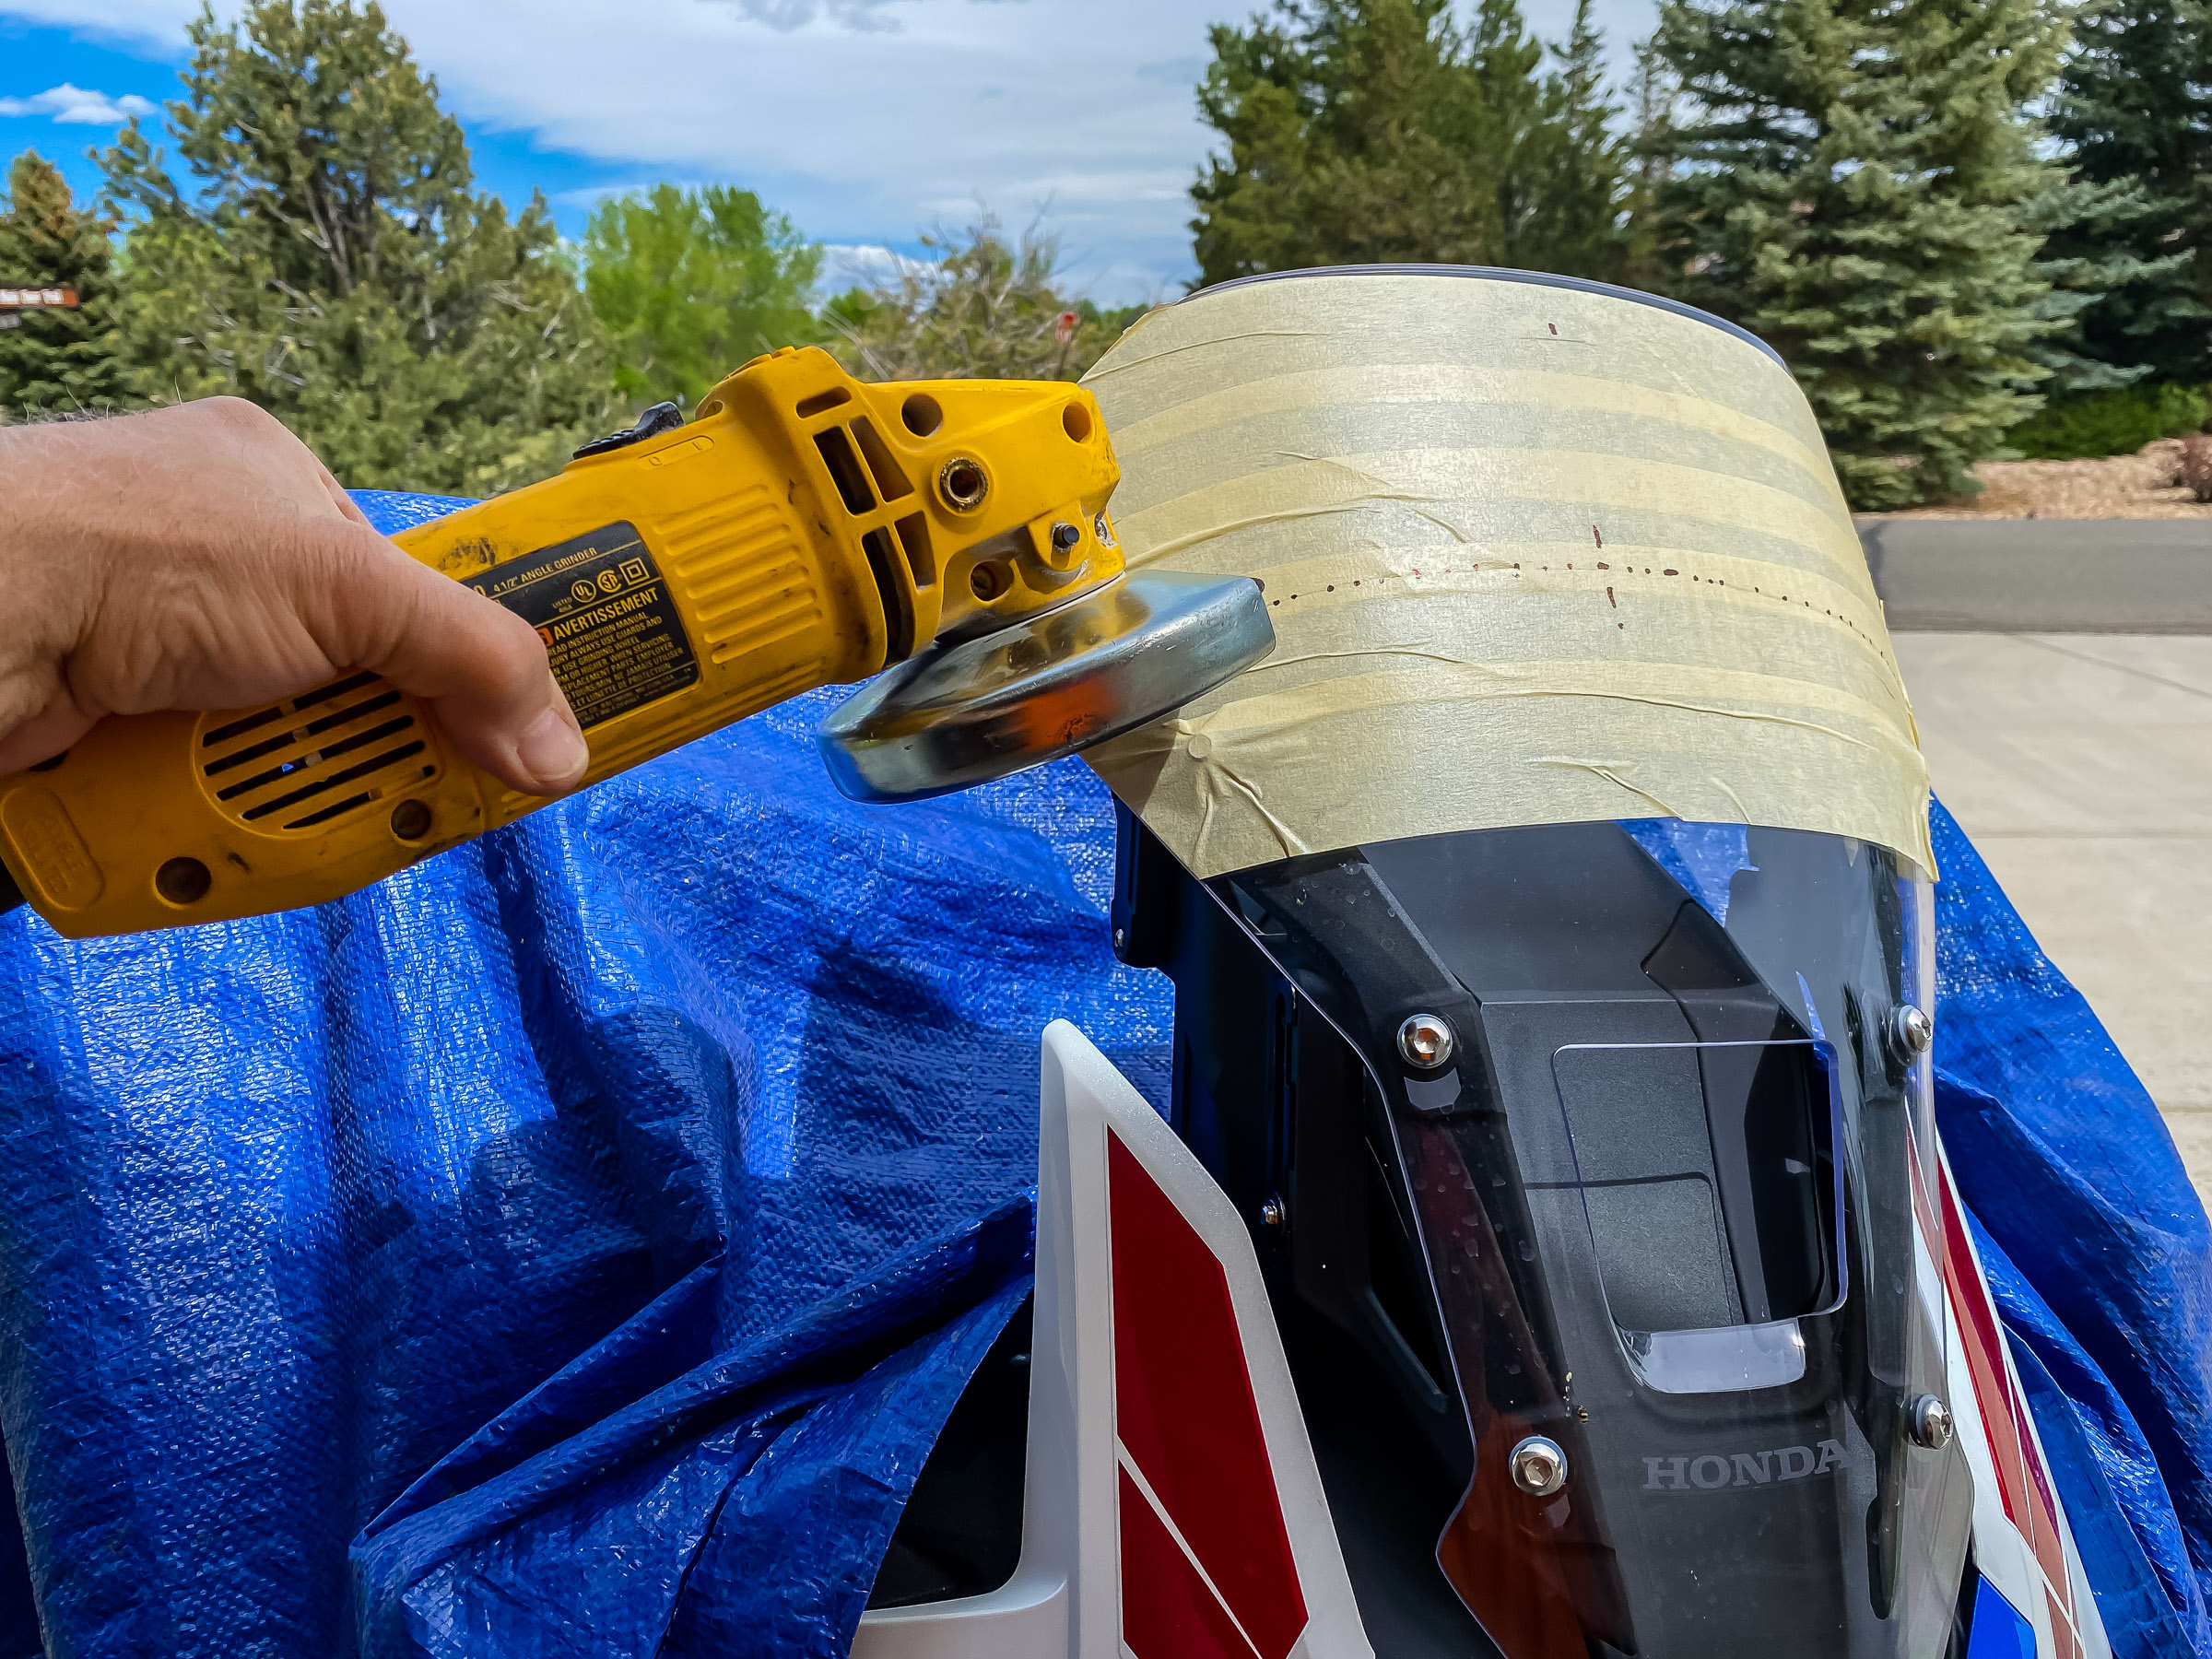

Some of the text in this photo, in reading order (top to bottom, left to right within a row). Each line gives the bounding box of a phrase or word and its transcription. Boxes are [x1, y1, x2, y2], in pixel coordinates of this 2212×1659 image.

[521, 563, 554, 582] ANGLE
[554, 547, 598, 570] GRINDER
[554, 587, 658, 640] AVERTISSEMENT
[567, 623, 617, 649] INSTRUCTION
[570, 642, 601, 659] ALWAYS
[600, 636, 617, 646] USE
[616, 626, 645, 639] GUARDS
[646, 616, 663, 627] AND
[609, 648, 633, 663] WHEN
[633, 633, 671, 653] SERVICING
[636, 641, 675, 662] EMPLOYER
[562, 660, 577, 672] USE
[578, 646, 615, 665] GRINDING
[614, 636, 641, 652] WHEEL
[653, 648, 684, 663] UTILISER
[1641, 1439, 1853, 1489] HONDA
